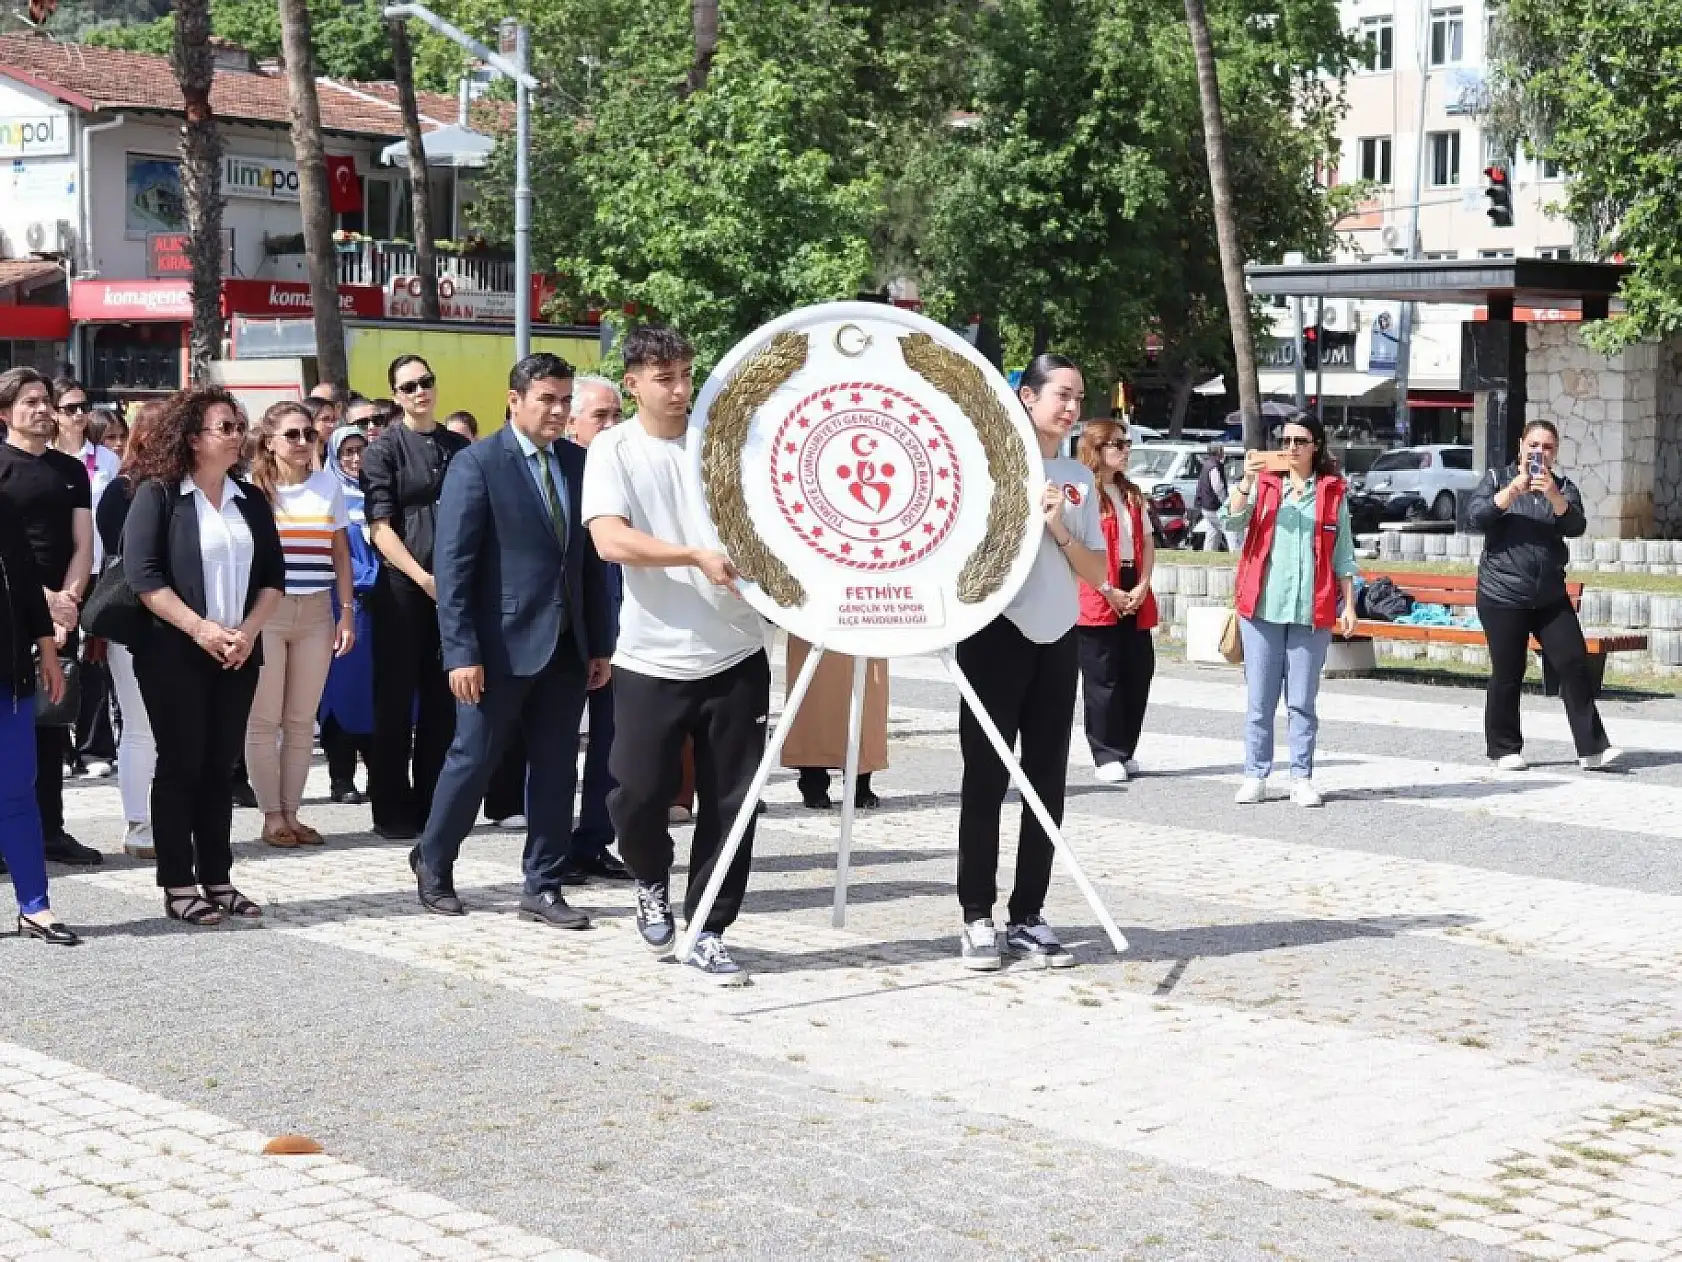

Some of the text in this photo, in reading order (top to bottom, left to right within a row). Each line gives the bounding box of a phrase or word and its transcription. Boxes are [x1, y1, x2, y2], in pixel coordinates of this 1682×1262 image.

[394, 277, 453, 298] FOO
[843, 413, 893, 428] GENÇLİK
[905, 437, 927, 468] SPOR
[845, 583, 914, 600] FETHİYE
[838, 603, 925, 614] GENÇLİK VE SPOR
[838, 615, 860, 626] İLÇE
